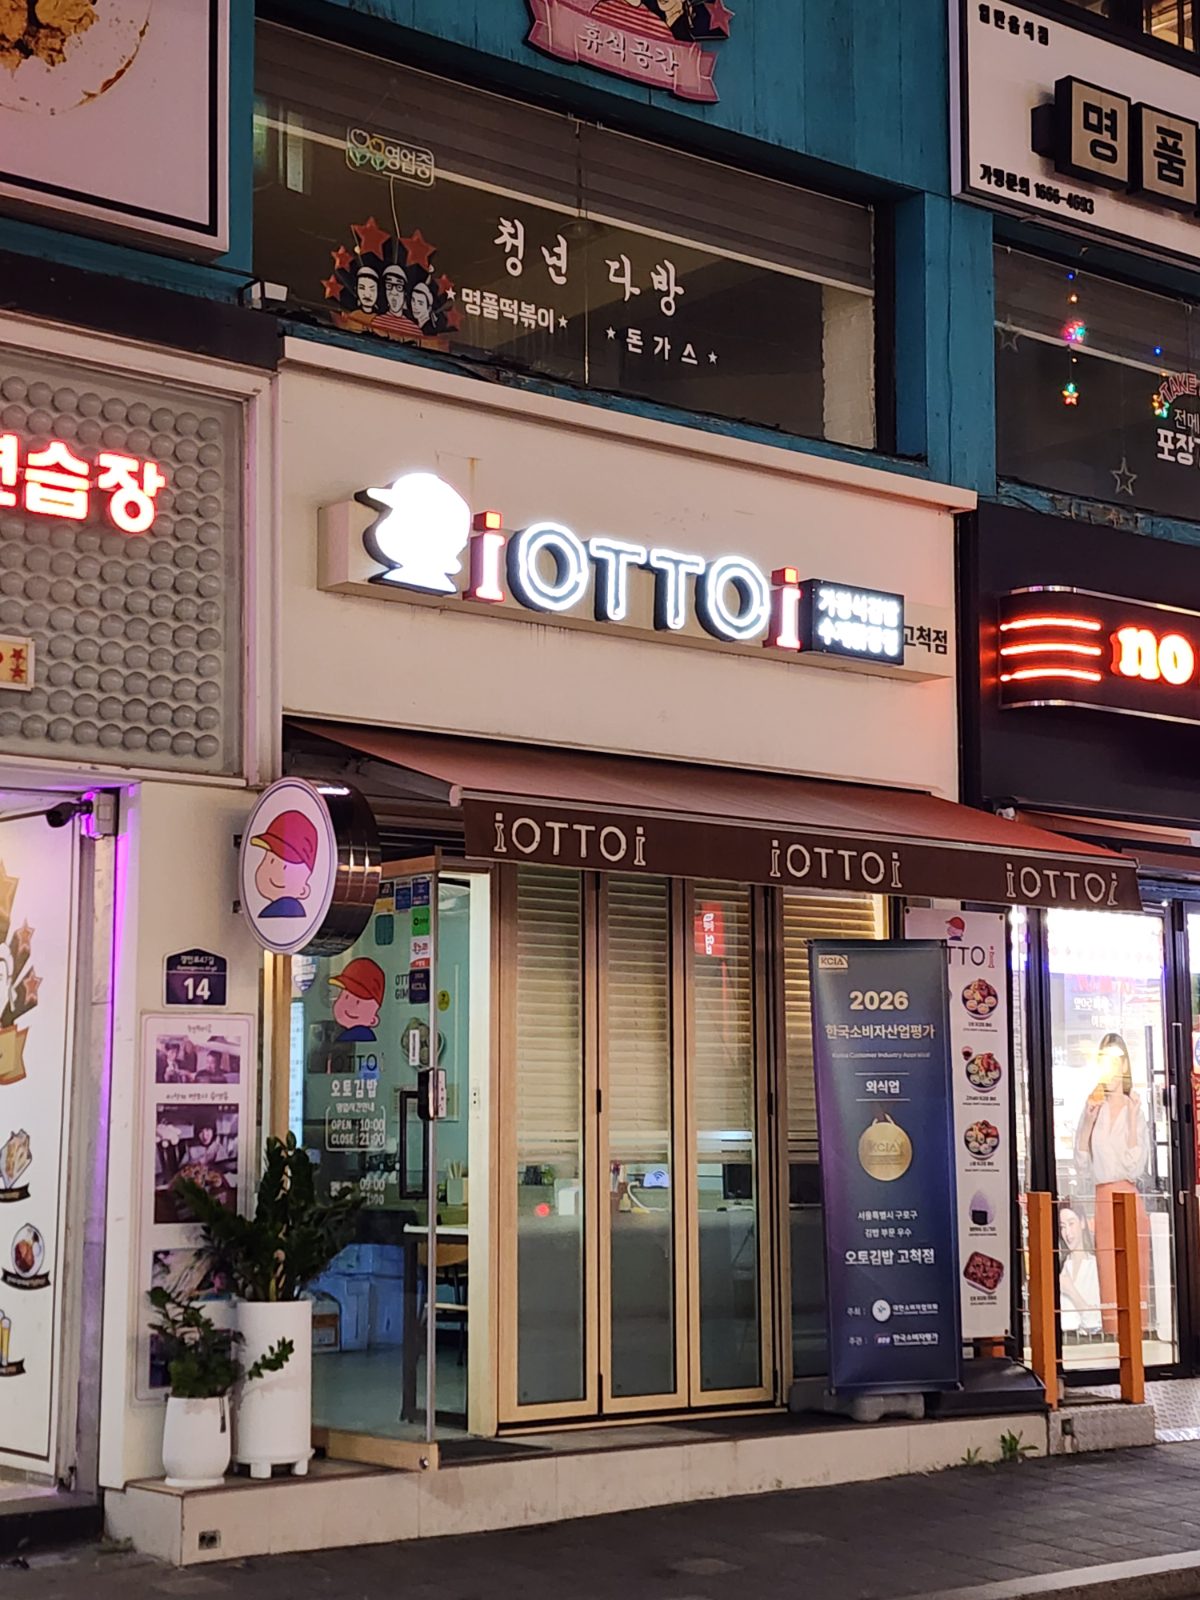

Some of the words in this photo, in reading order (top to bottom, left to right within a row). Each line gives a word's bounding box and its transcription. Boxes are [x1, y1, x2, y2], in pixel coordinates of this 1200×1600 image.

[578, 22, 680, 78] 휴식공간
[1083, 101, 1187, 187] 명품
[385, 145, 433, 178] 영업중
[461, 287, 555, 334] 명품떡볶이
[1159, 372, 1197, 404] TAKE
[904, 625, 948, 655] 고척점
[493, 812, 647, 866] iOTTOi
[769, 839, 902, 888] iOTTOi
[1006, 862, 1118, 906] iOTTOi
[184, 977, 211, 1001] 14
[850, 990, 909, 1011] 2026
[825, 1023, 935, 1040] 한국소비자산업평가
[331, 1079, 377, 1098] 오토김밥
[866, 1080, 900, 1094] 외식업
[331, 1119, 352, 1131] OPEN
[845, 1250, 893, 1265] 오토김밥
[897, 1249, 935, 1264] 고척점
